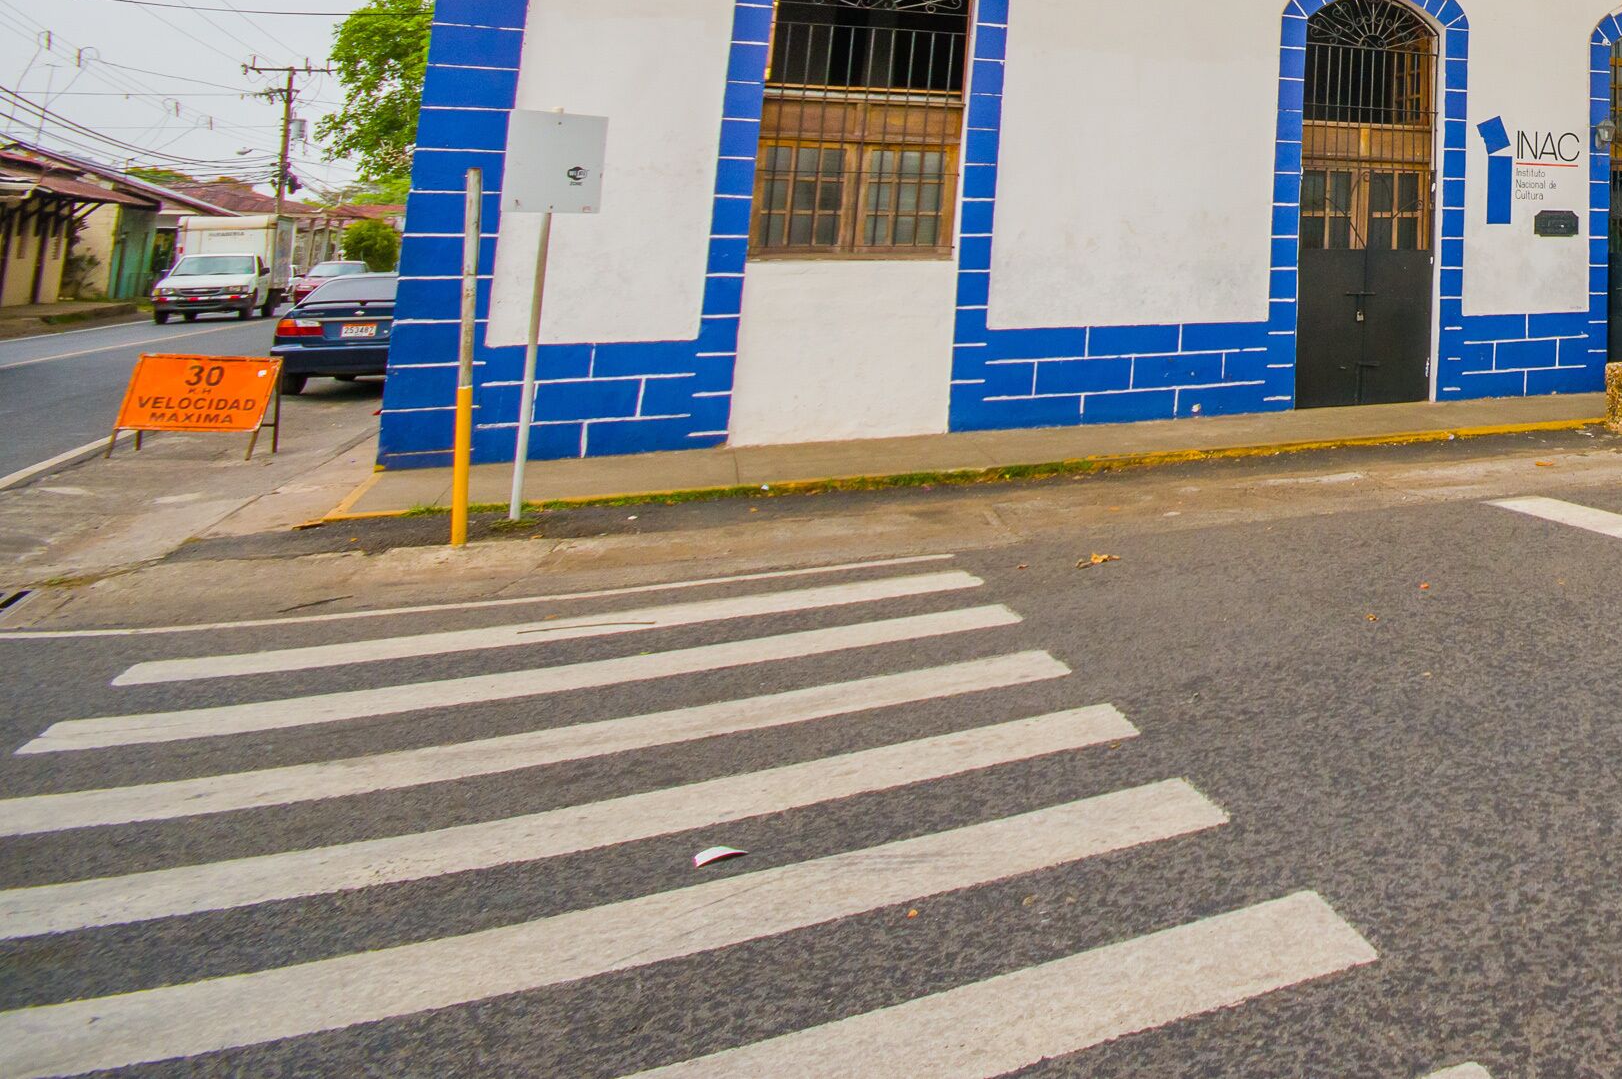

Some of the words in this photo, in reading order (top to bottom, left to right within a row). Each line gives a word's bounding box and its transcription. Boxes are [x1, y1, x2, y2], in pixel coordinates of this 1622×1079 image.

[1516, 130, 1580, 162] INAC
[1515, 167, 1546, 178] Instituto
[1515, 178, 1547, 190] Nacional
[1548, 180, 1557, 190] de
[1514, 189, 1544, 201] Cultura
[184, 364, 225, 387] 30
[137, 395, 257, 412] VELOCIDAD
[149, 411, 234, 425] MAXIMA
